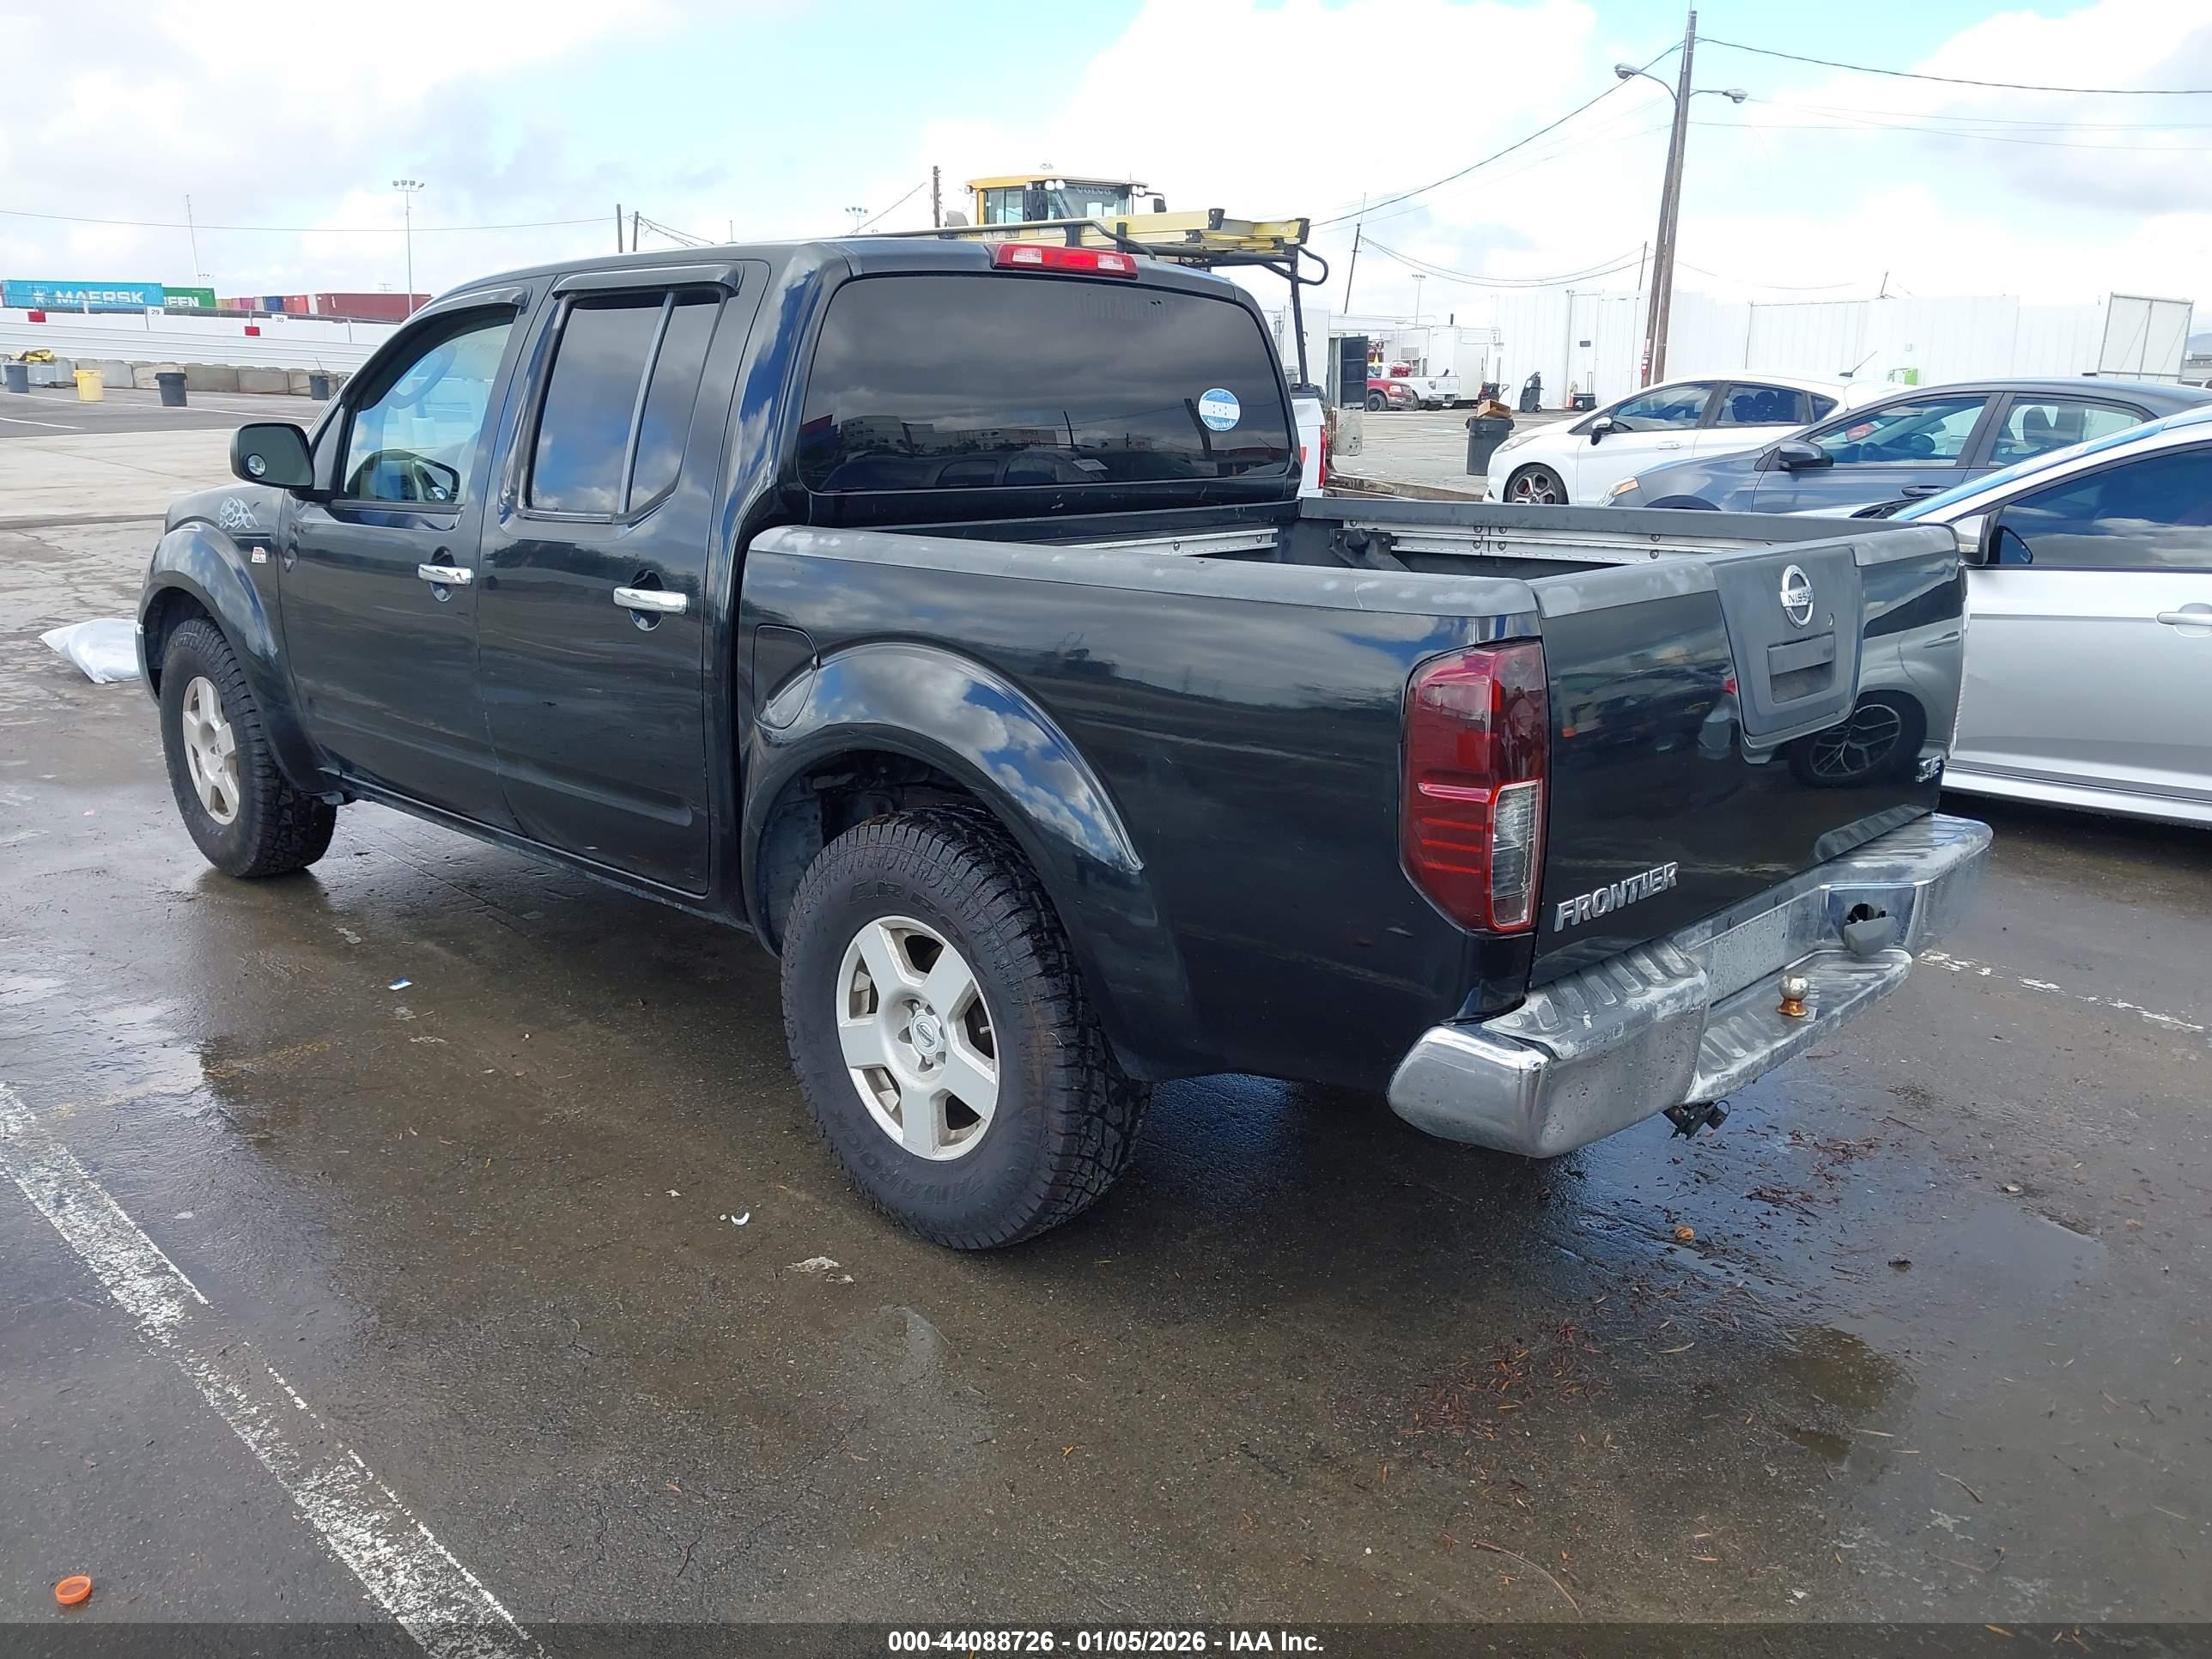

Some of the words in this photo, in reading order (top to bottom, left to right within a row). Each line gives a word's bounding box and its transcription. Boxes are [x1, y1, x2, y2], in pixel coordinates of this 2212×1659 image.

[1077, 185, 1111, 196] VOLVO
[54, 290, 144, 304] MAERSK
[1553, 861, 1679, 933] FRONTIER
